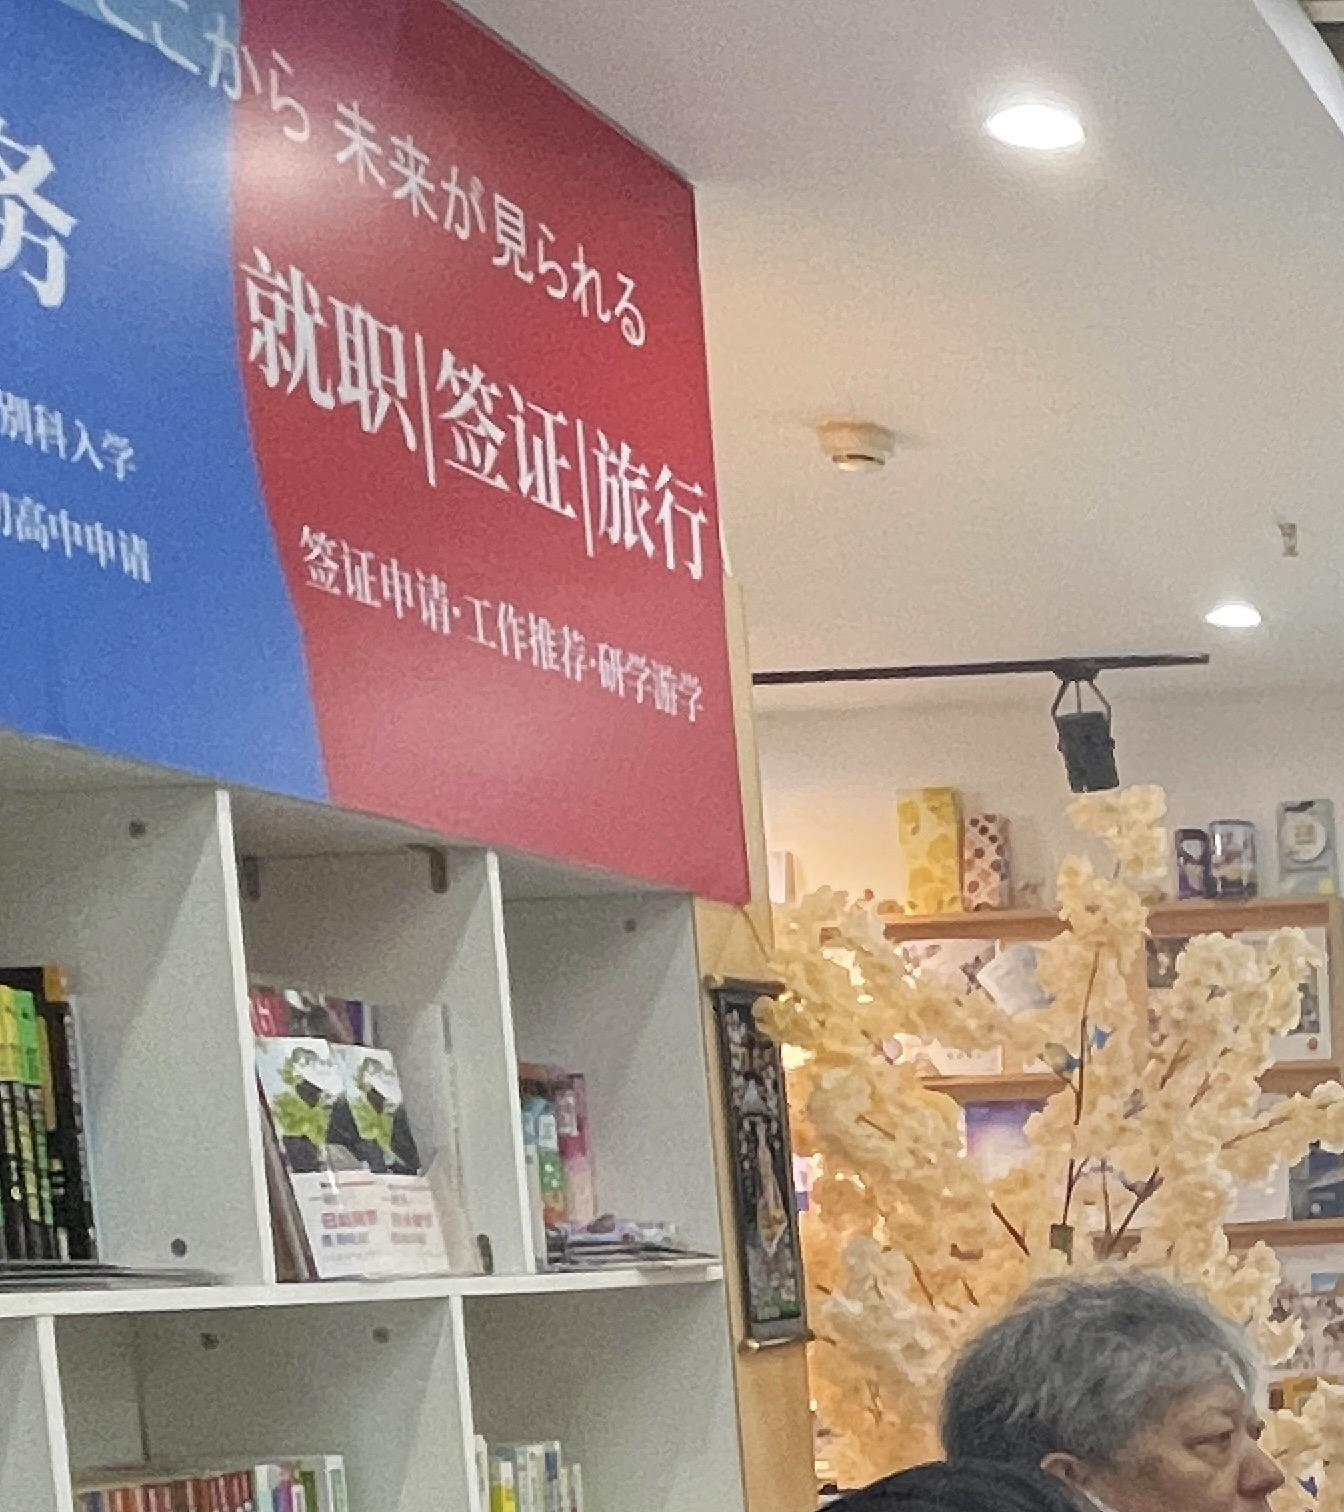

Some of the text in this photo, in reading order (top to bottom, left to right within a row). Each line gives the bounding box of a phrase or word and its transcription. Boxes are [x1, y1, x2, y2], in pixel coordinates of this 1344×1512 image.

[333, 100, 647, 348] 未来が見られる
